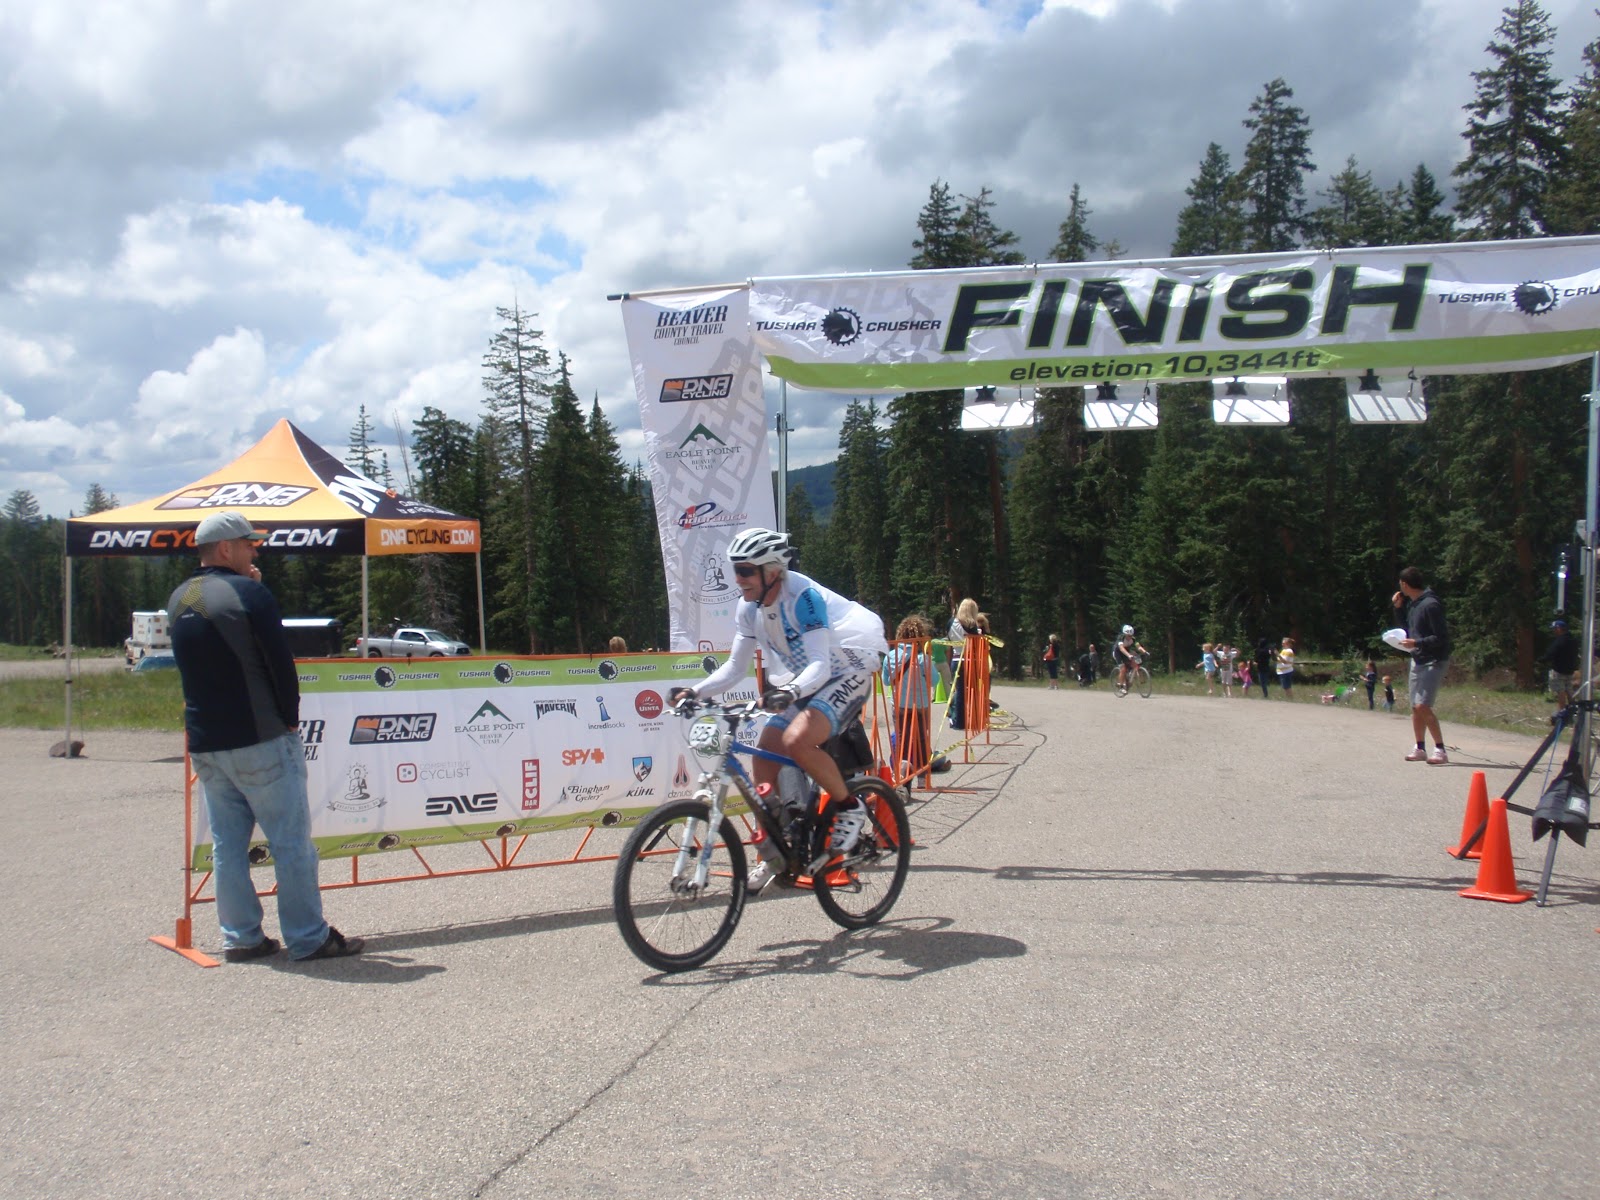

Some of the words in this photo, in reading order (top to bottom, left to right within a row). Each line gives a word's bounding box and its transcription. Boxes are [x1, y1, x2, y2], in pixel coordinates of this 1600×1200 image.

[1438, 291, 1507, 304] TUSHAR
[942, 261, 1433, 352] FINISH
[656, 305, 728, 327] BEAVER
[654, 325, 690, 339] COUNTY
[691, 323, 724, 336] TRAVEL
[755, 320, 817, 331] TUSHAR
[866, 319, 942, 332] CRUSHER
[673, 337, 699, 346] COUNCIL
[1010, 358, 1152, 381] elevation
[1165, 350, 1321, 377] 10,344ft
[682, 376, 730, 392] DNA
[681, 389, 727, 399] CYCLING
[665, 449, 702, 459] EAGLE
[706, 446, 741, 456] POINT
[211, 484, 311, 498] DNA
[199, 497, 291, 506] CYCLING
[380, 529, 475, 545] DNACYCLING.COM
[620, 664, 657, 673] CRUSHER
[672, 662, 701, 670] TUSHAR
[398, 672, 440, 680] CRUSHER
[722, 691, 756, 704] CAMELBAK
[829, 674, 865, 708] RMCC
[536, 702, 577, 720] MAVERIK
[378, 715, 434, 732] DNA
[454, 724, 490, 733] EAGLE
[492, 722, 525, 731] POINT
[376, 732, 430, 742] CYCLING
[420, 768, 470, 780] CYCLIST
[524, 762, 538, 799] CLIF
[567, 784, 610, 795] Bingham
[626, 786, 655, 797] KÜHL
[425, 792, 499, 816] ENVE
[524, 799, 538, 807] BAR
[575, 793, 603, 802] Cyclery
[340, 841, 375, 849] TUSHAR
